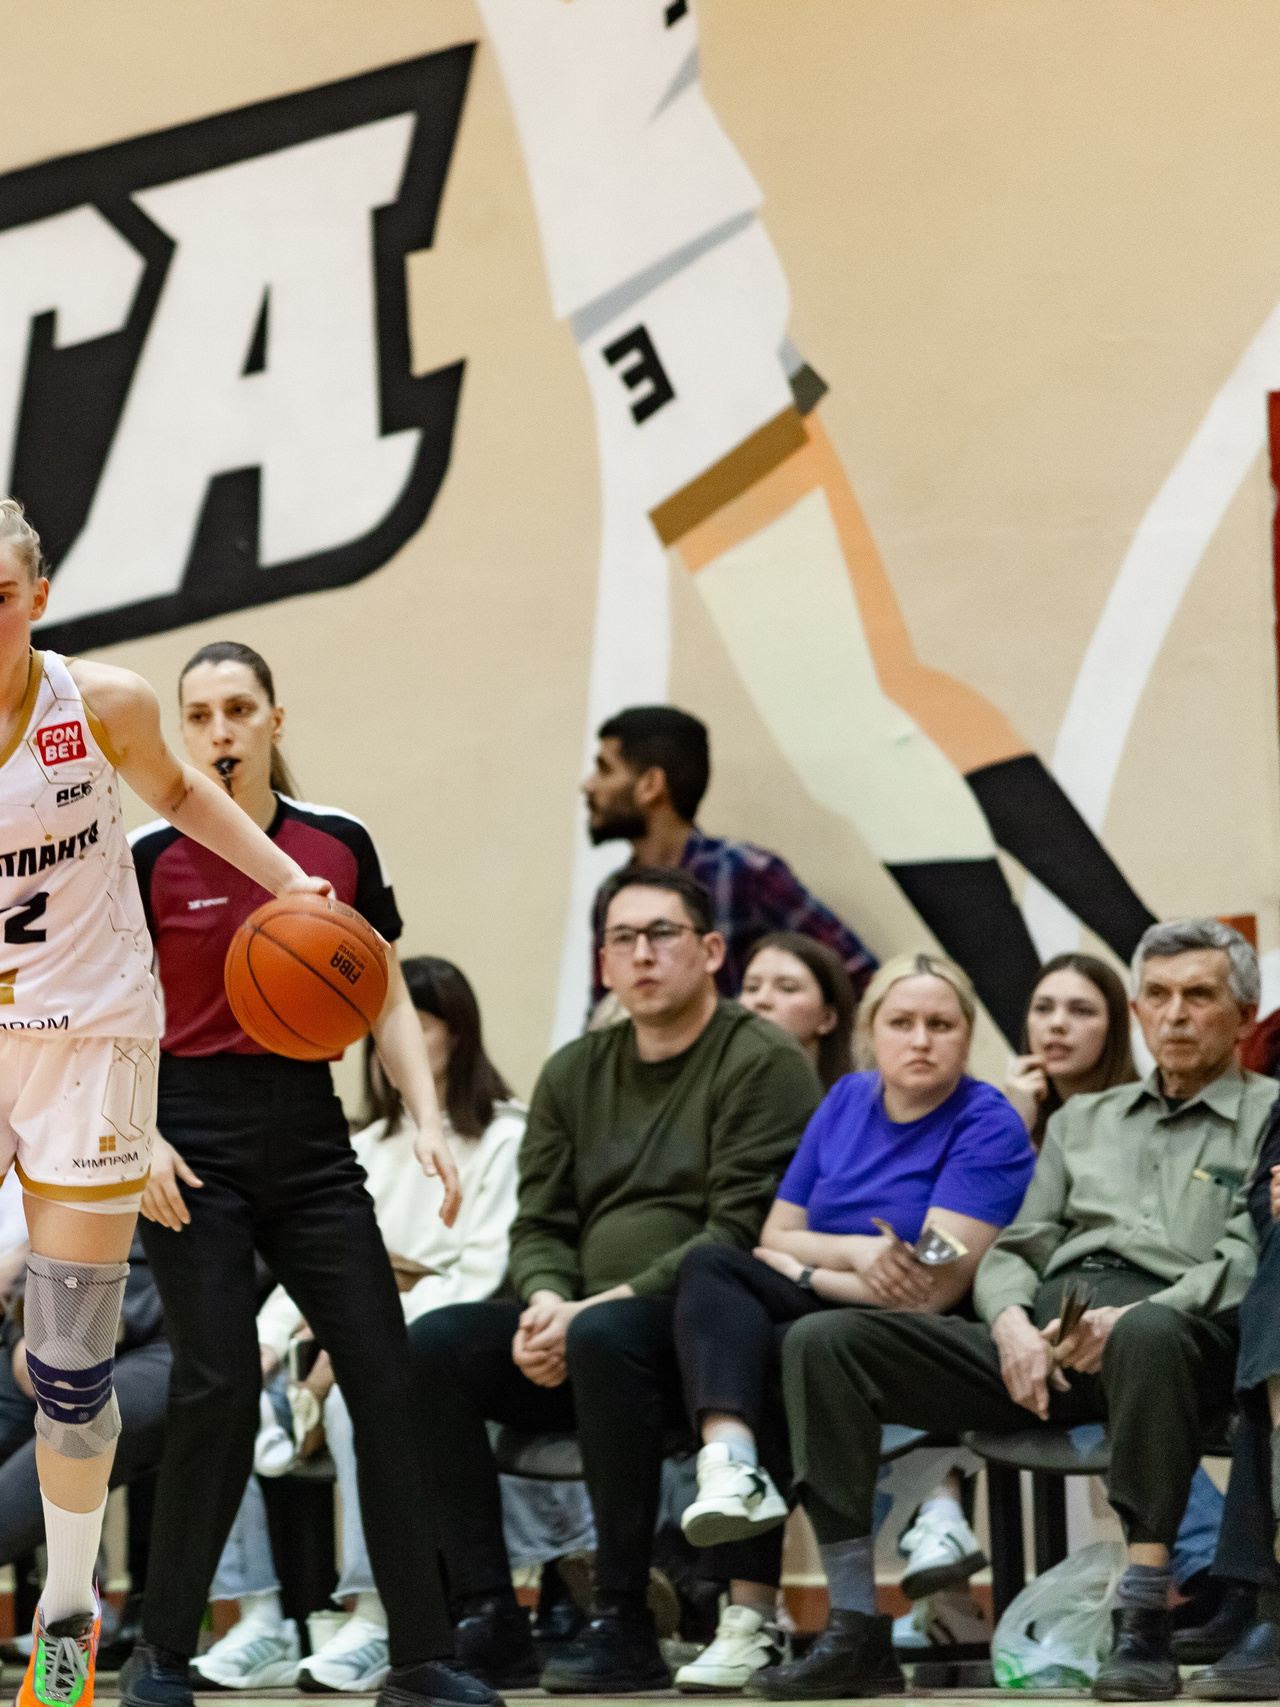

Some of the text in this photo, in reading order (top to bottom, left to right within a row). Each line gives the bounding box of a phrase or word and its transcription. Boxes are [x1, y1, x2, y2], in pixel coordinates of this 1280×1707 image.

[41, 724, 79, 747] FON
[44, 739, 82, 762] BET
[330, 951, 361, 985] FIBA
[71, 1151, 139, 1169] ХИМПРОМ
